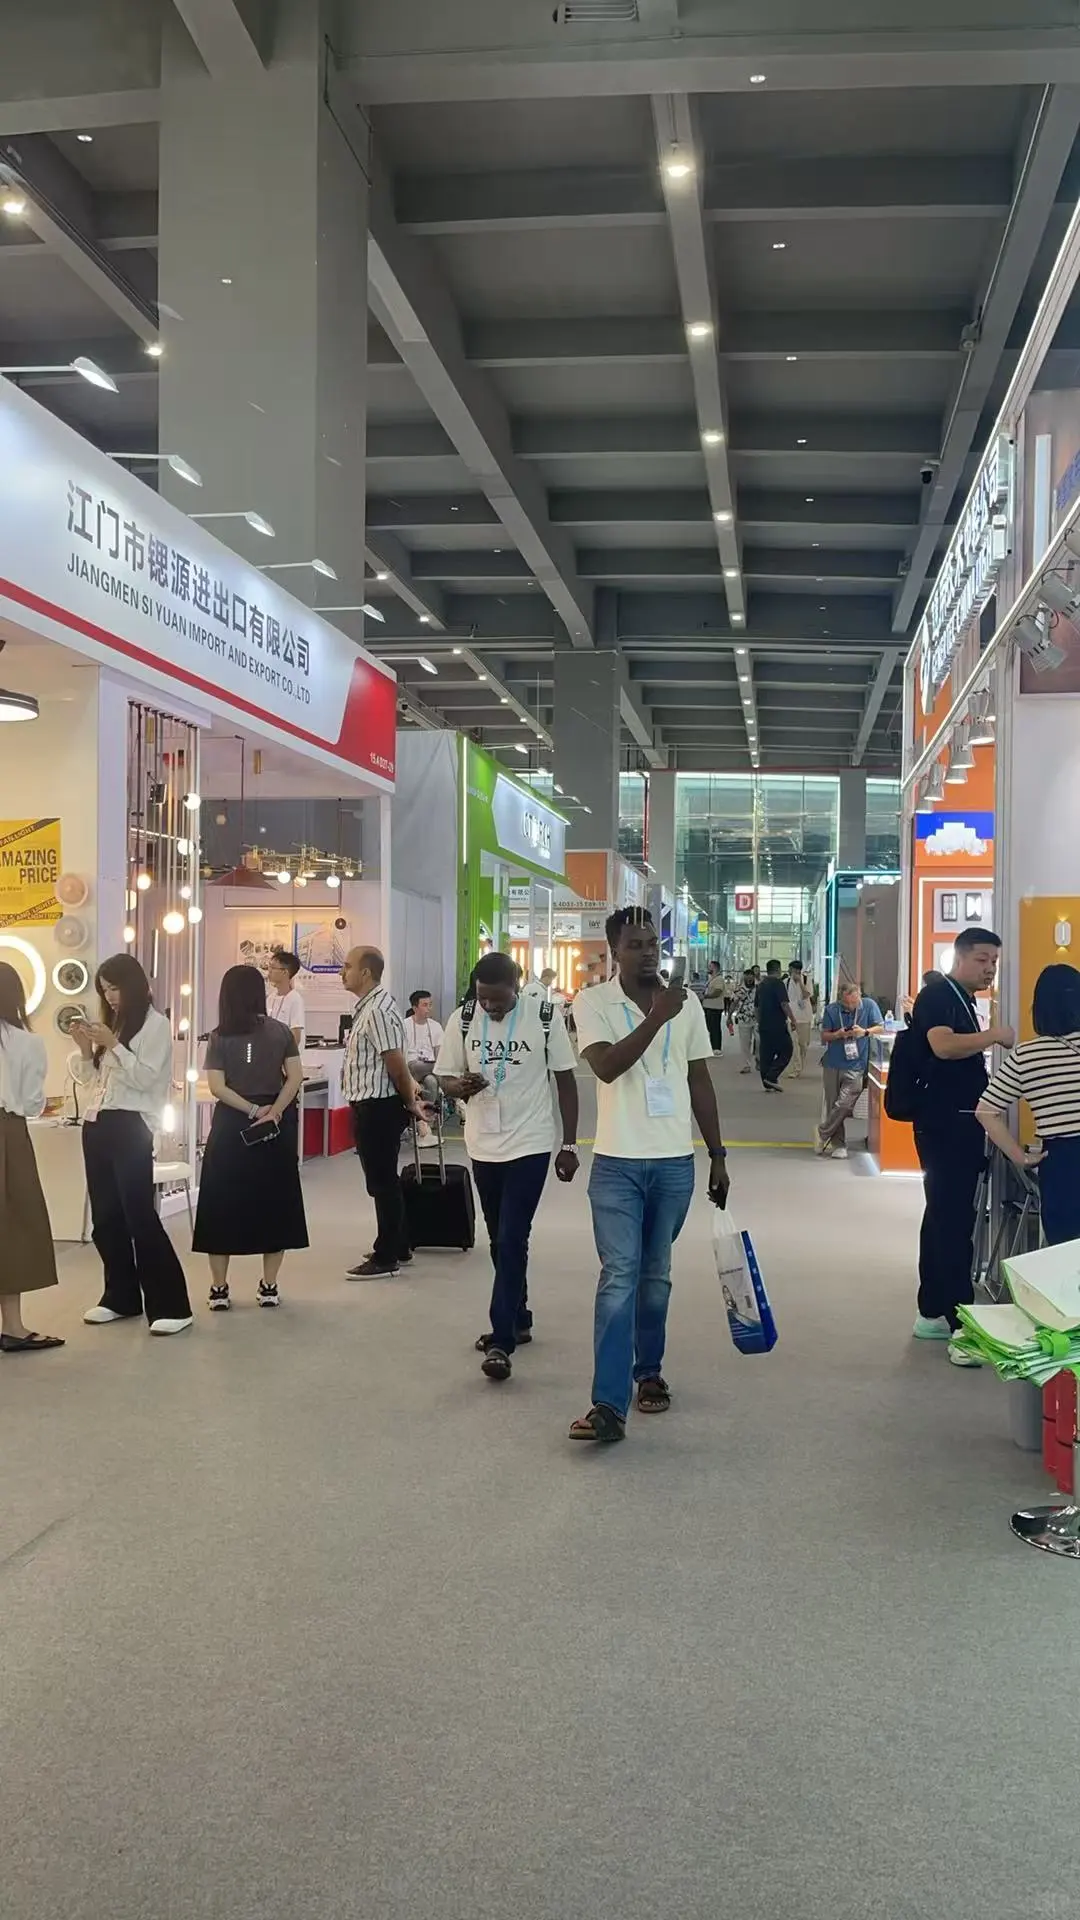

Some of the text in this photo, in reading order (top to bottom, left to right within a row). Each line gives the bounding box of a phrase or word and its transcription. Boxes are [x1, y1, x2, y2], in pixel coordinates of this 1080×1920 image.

[67, 480, 310, 676] 江门市锶源进出口有限公司
[67, 552, 139, 610] JIANGMEN
[142, 594, 153, 617] SI
[155, 601, 187, 636] YUAN
[189, 621, 227, 658] IMPORT
[228, 645, 247, 669] AND
[249, 656, 281, 688] EXPORT
[0, 848, 57, 867] MAZING
[20, 867, 57, 885] PRICE
[739, 894, 752, 909] D
[471, 1039, 531, 1052] PRADA
